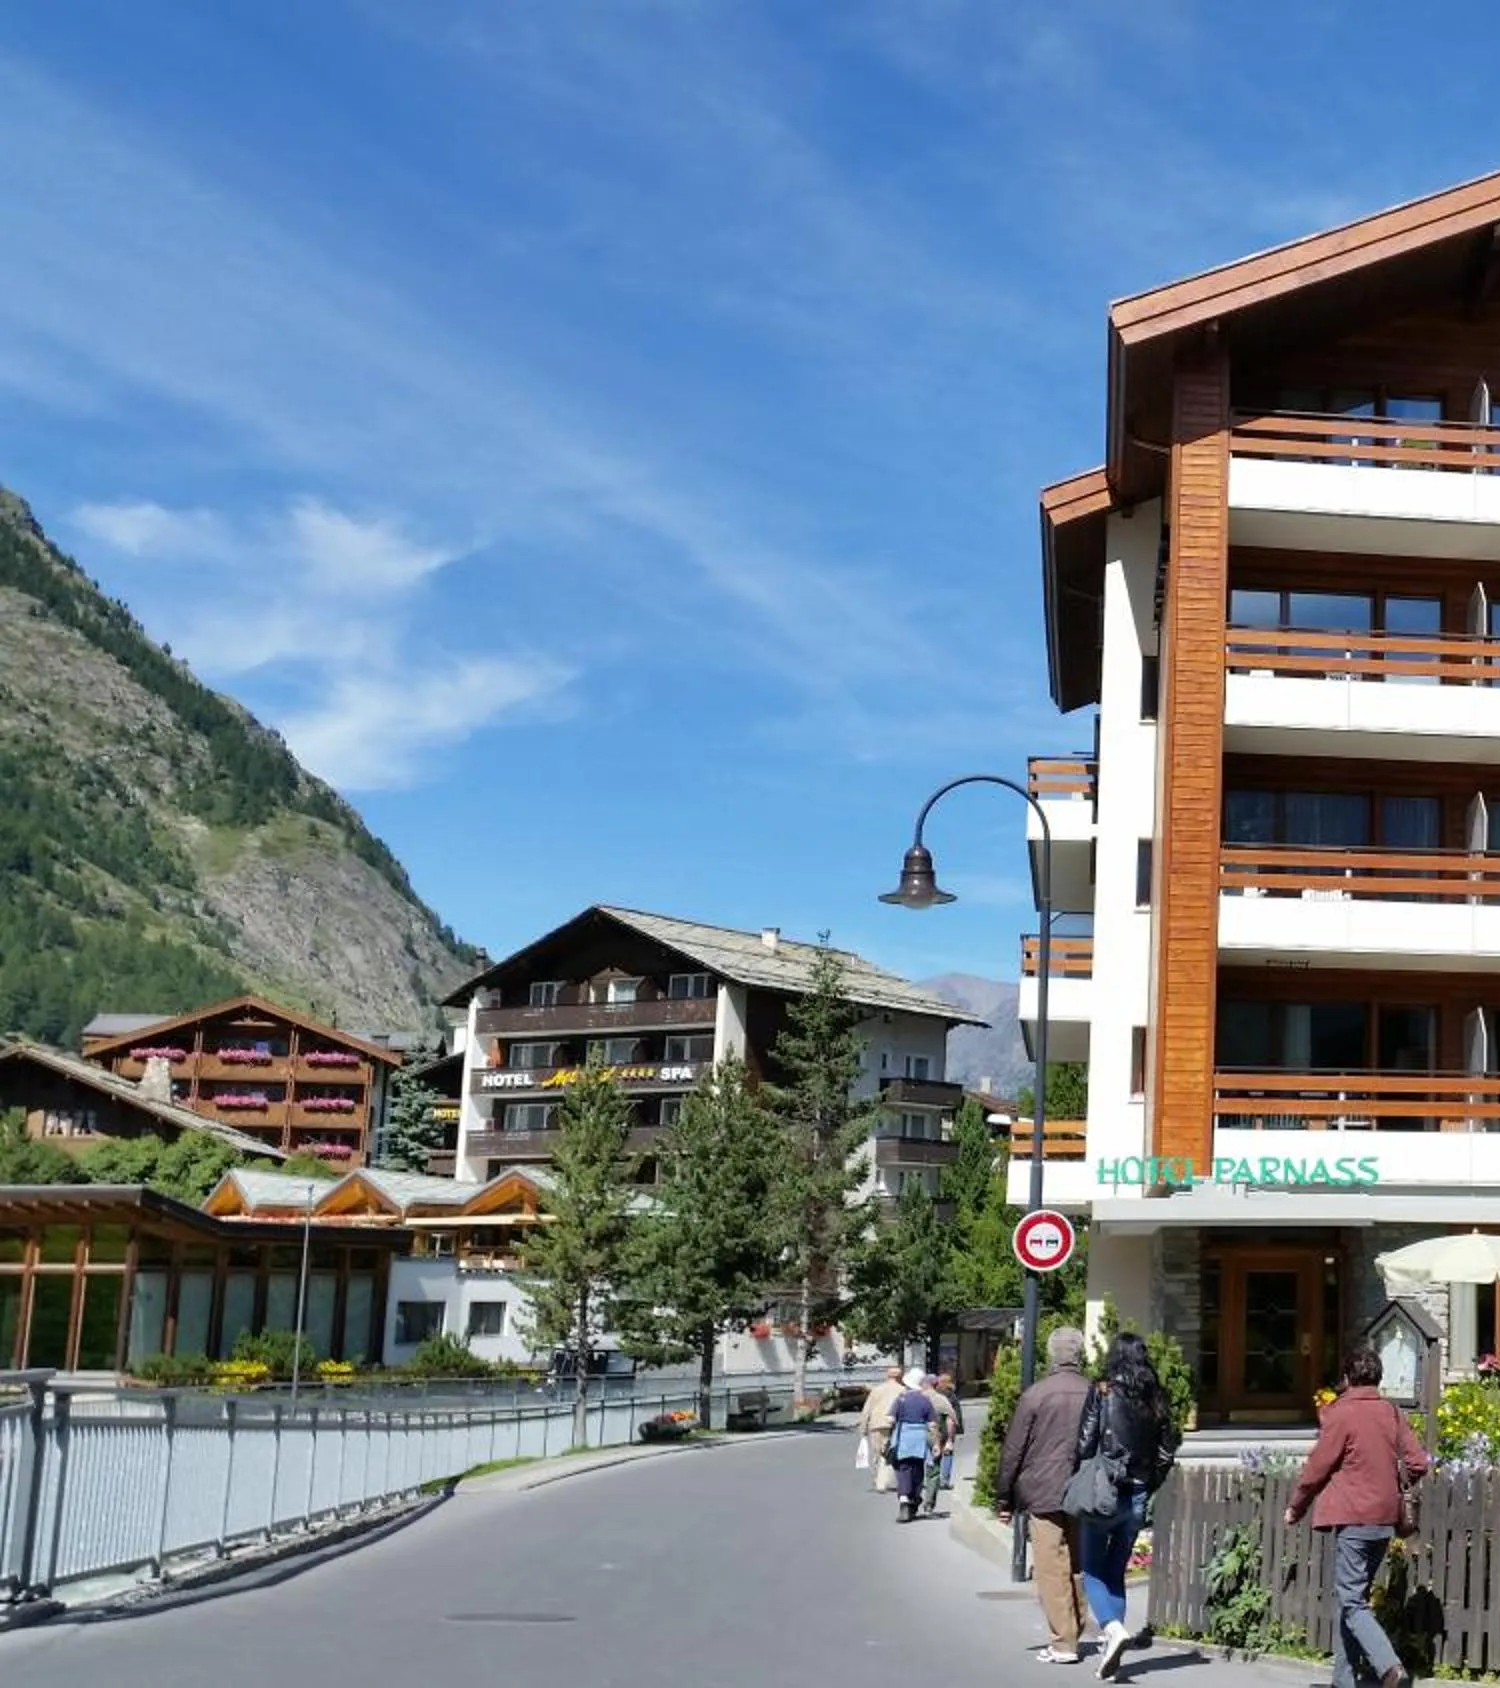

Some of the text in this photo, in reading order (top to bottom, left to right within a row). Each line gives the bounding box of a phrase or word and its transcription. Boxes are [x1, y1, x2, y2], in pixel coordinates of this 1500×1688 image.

[481, 1072, 534, 1087] HOTEL
[659, 1066, 693, 1080] SPA
[1097, 1156, 1379, 1186] HOTEL PARNASS
